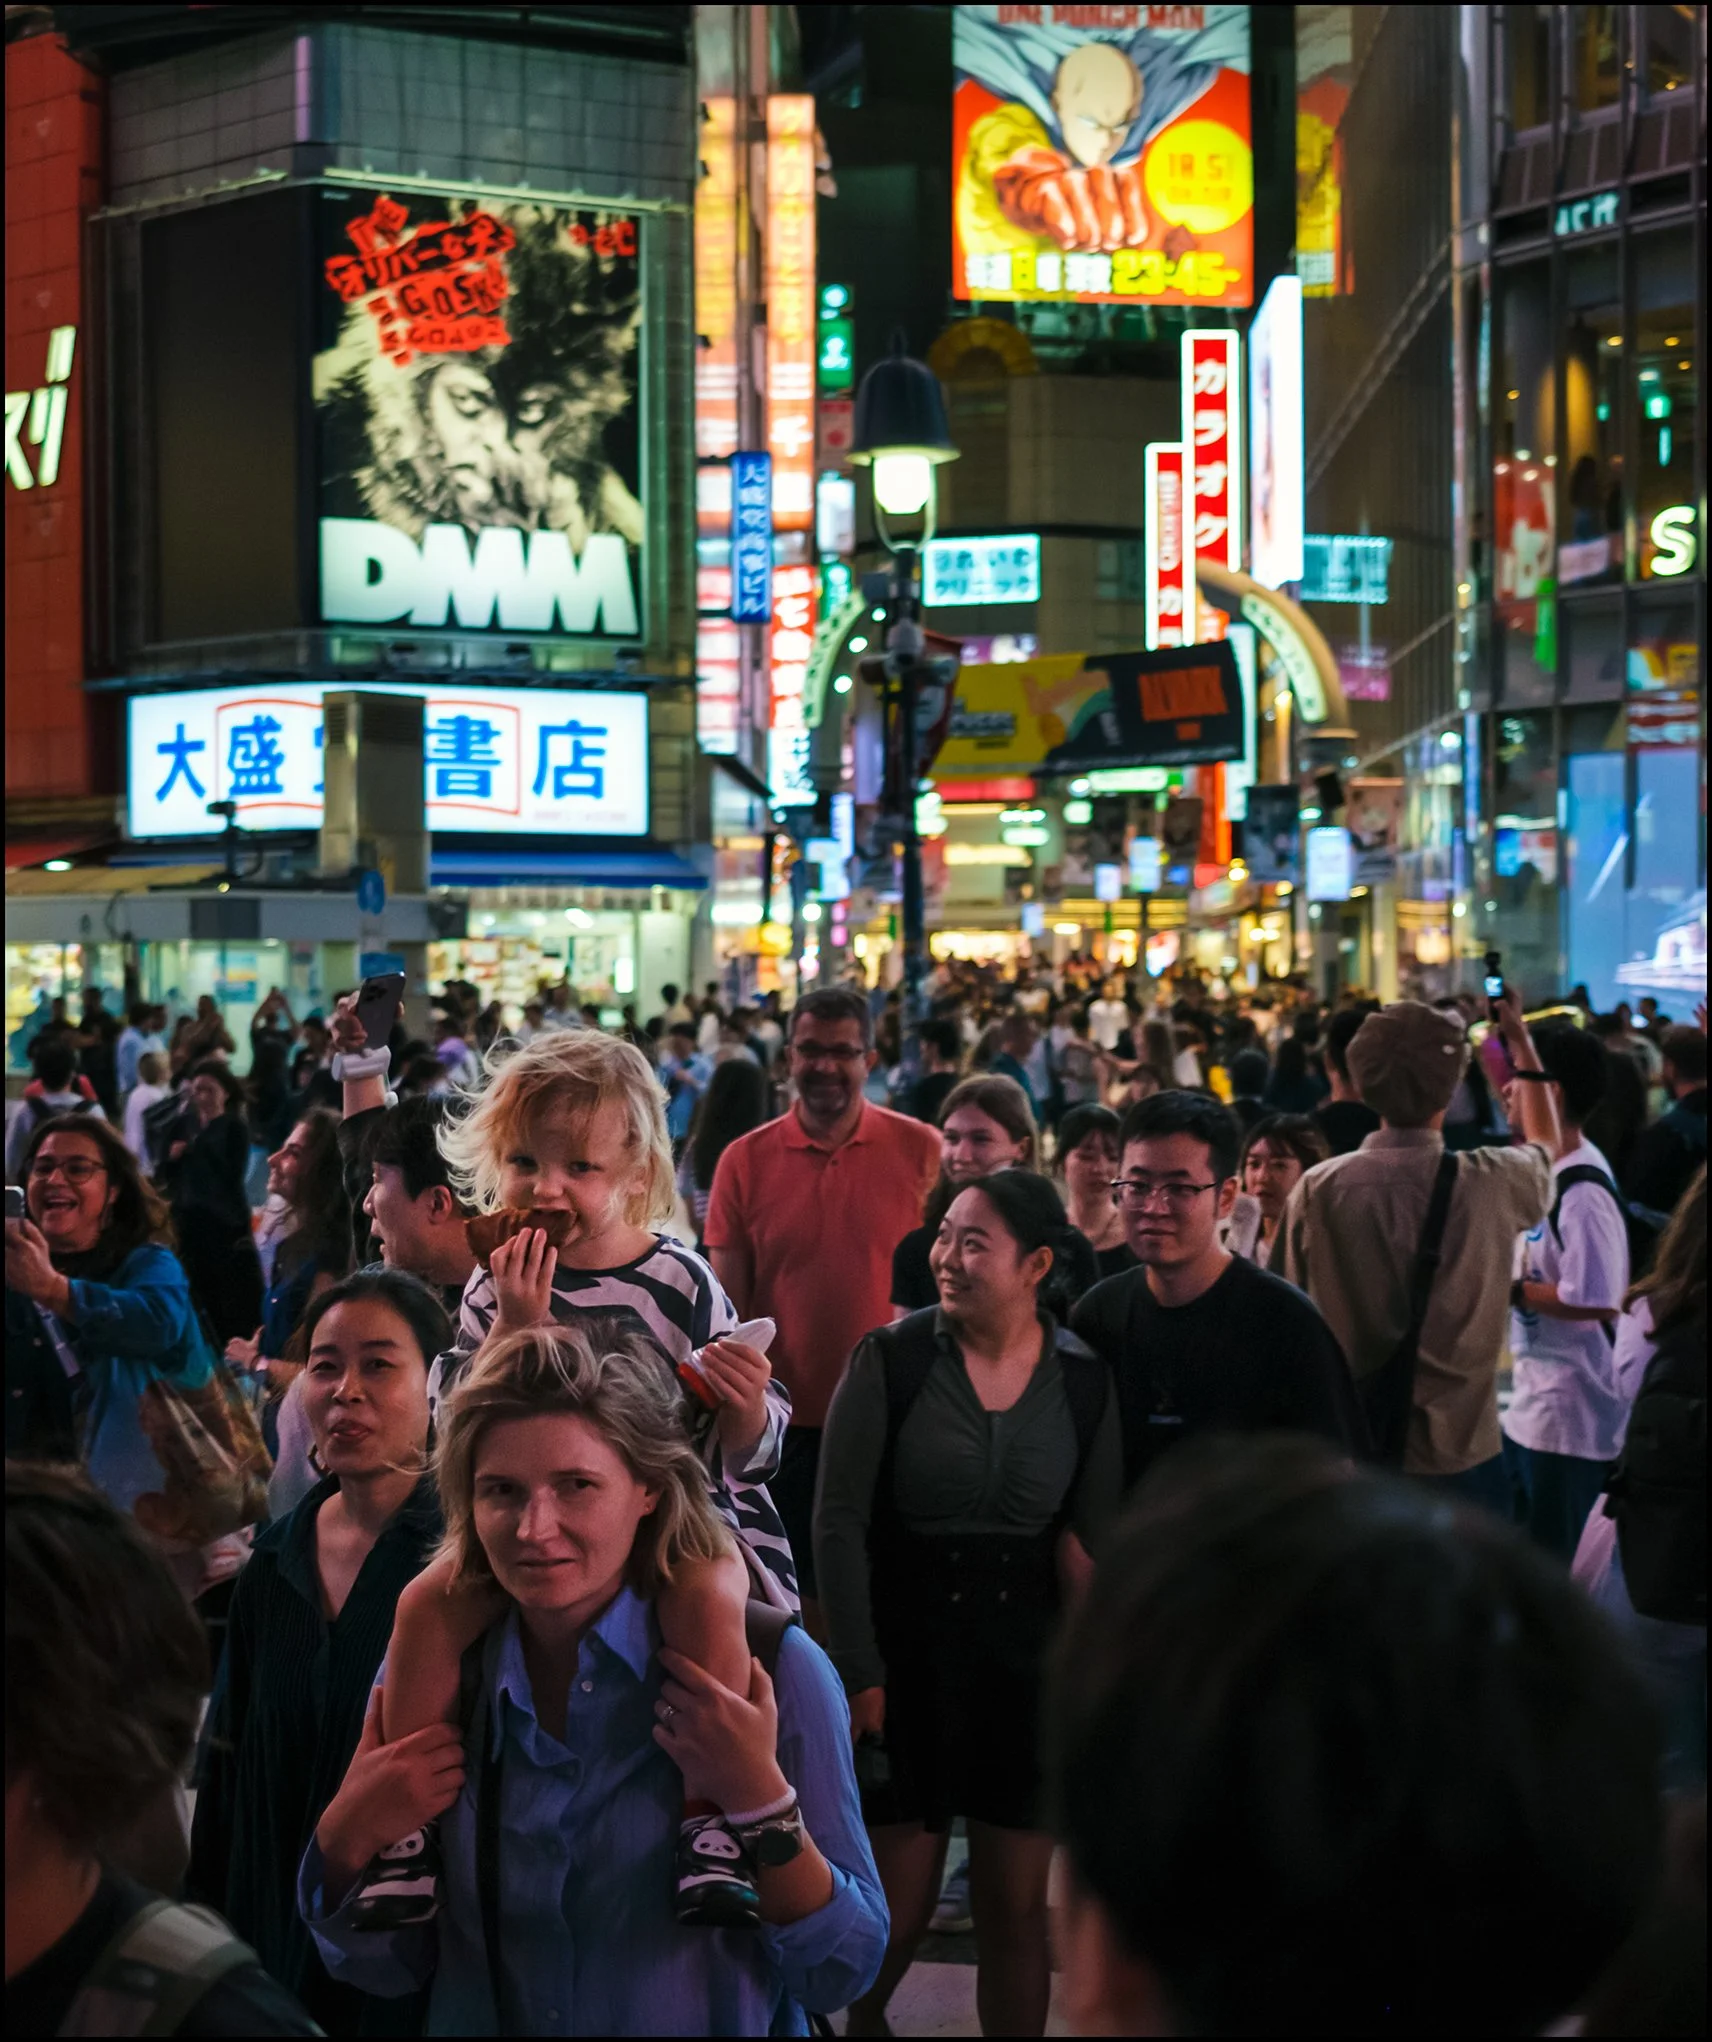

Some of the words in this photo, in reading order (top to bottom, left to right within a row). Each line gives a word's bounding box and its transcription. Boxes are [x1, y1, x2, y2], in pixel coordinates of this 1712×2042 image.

[1194, 358, 1229, 549] カラオケ
[321, 522, 638, 633] DMM
[1650, 505, 1698, 576] S
[155, 714, 608, 803] 大盛書店
